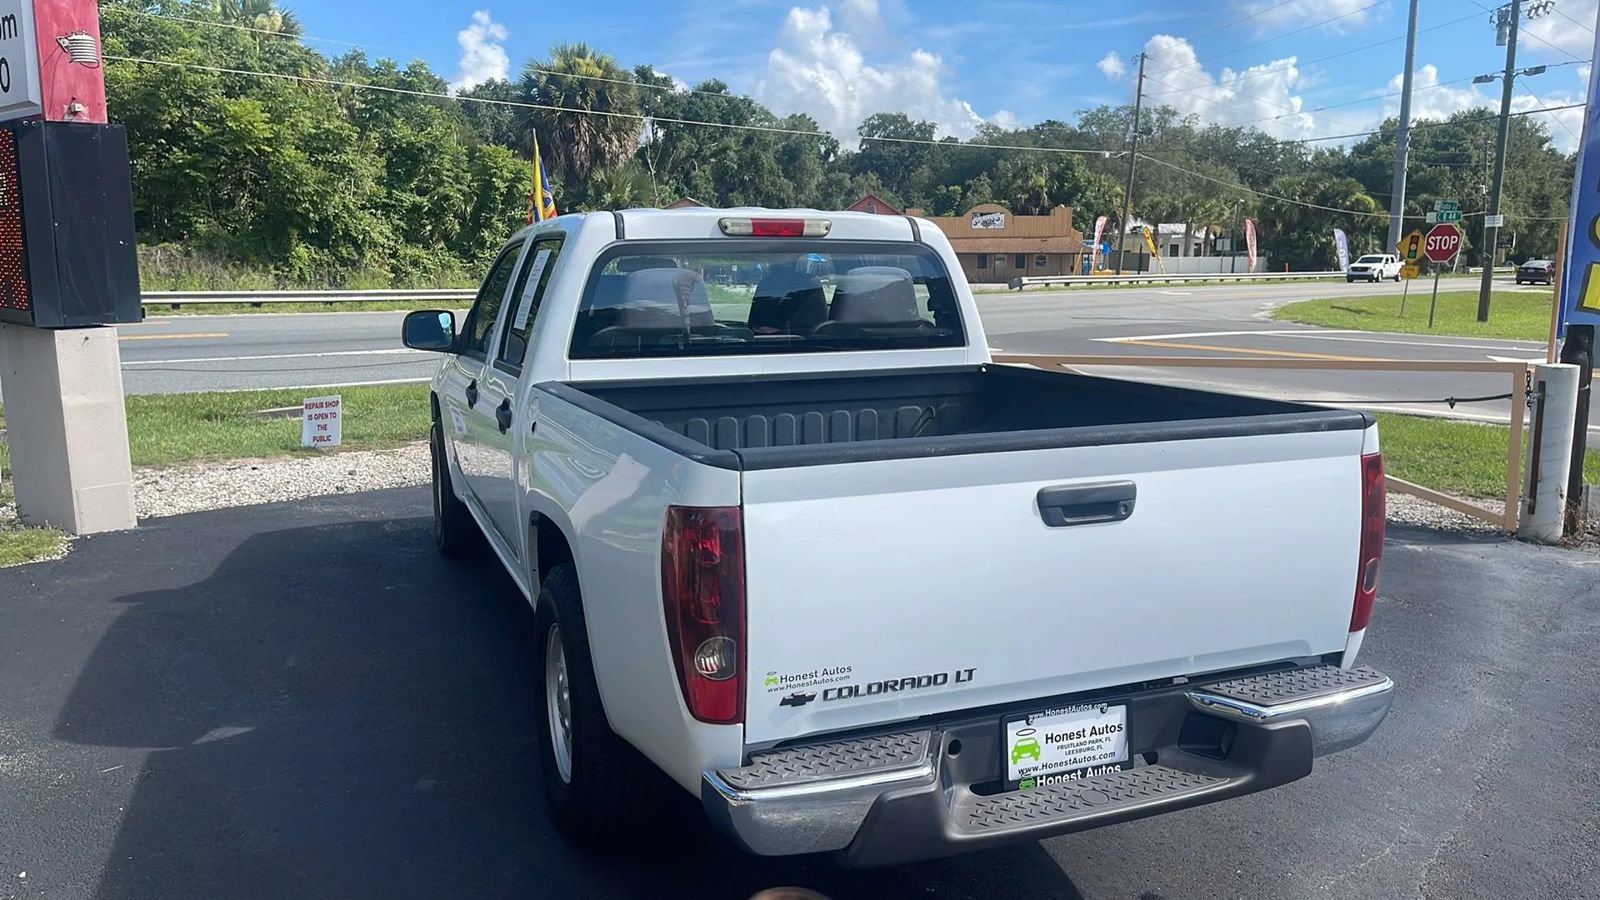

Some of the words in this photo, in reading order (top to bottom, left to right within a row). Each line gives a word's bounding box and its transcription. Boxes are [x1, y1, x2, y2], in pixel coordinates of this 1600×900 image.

[0, 13, 17, 40] m
[1427, 235, 1458, 251] STOP
[325, 400, 339, 408] SHOP
[314, 412, 328, 420] OPEN
[767, 674, 850, 693] www.HonestAutos.com
[780, 670, 819, 684] Honest
[822, 665, 853, 677] Autos
[822, 672, 949, 702] COLORADO
[955, 667, 978, 684] LT
[1028, 702, 1108, 720] www.HonestAutos.com
[1045, 727, 1086, 745] Honest
[1089, 722, 1124, 737] Autos
[1056, 741, 1088, 751] FRUITLAND
[1088, 738, 1103, 746] PARK,
[1018, 751, 1116, 774] www.HonestAutos.com
[1036, 770, 1082, 787] Honest
[1085, 764, 1121, 778] Autos
